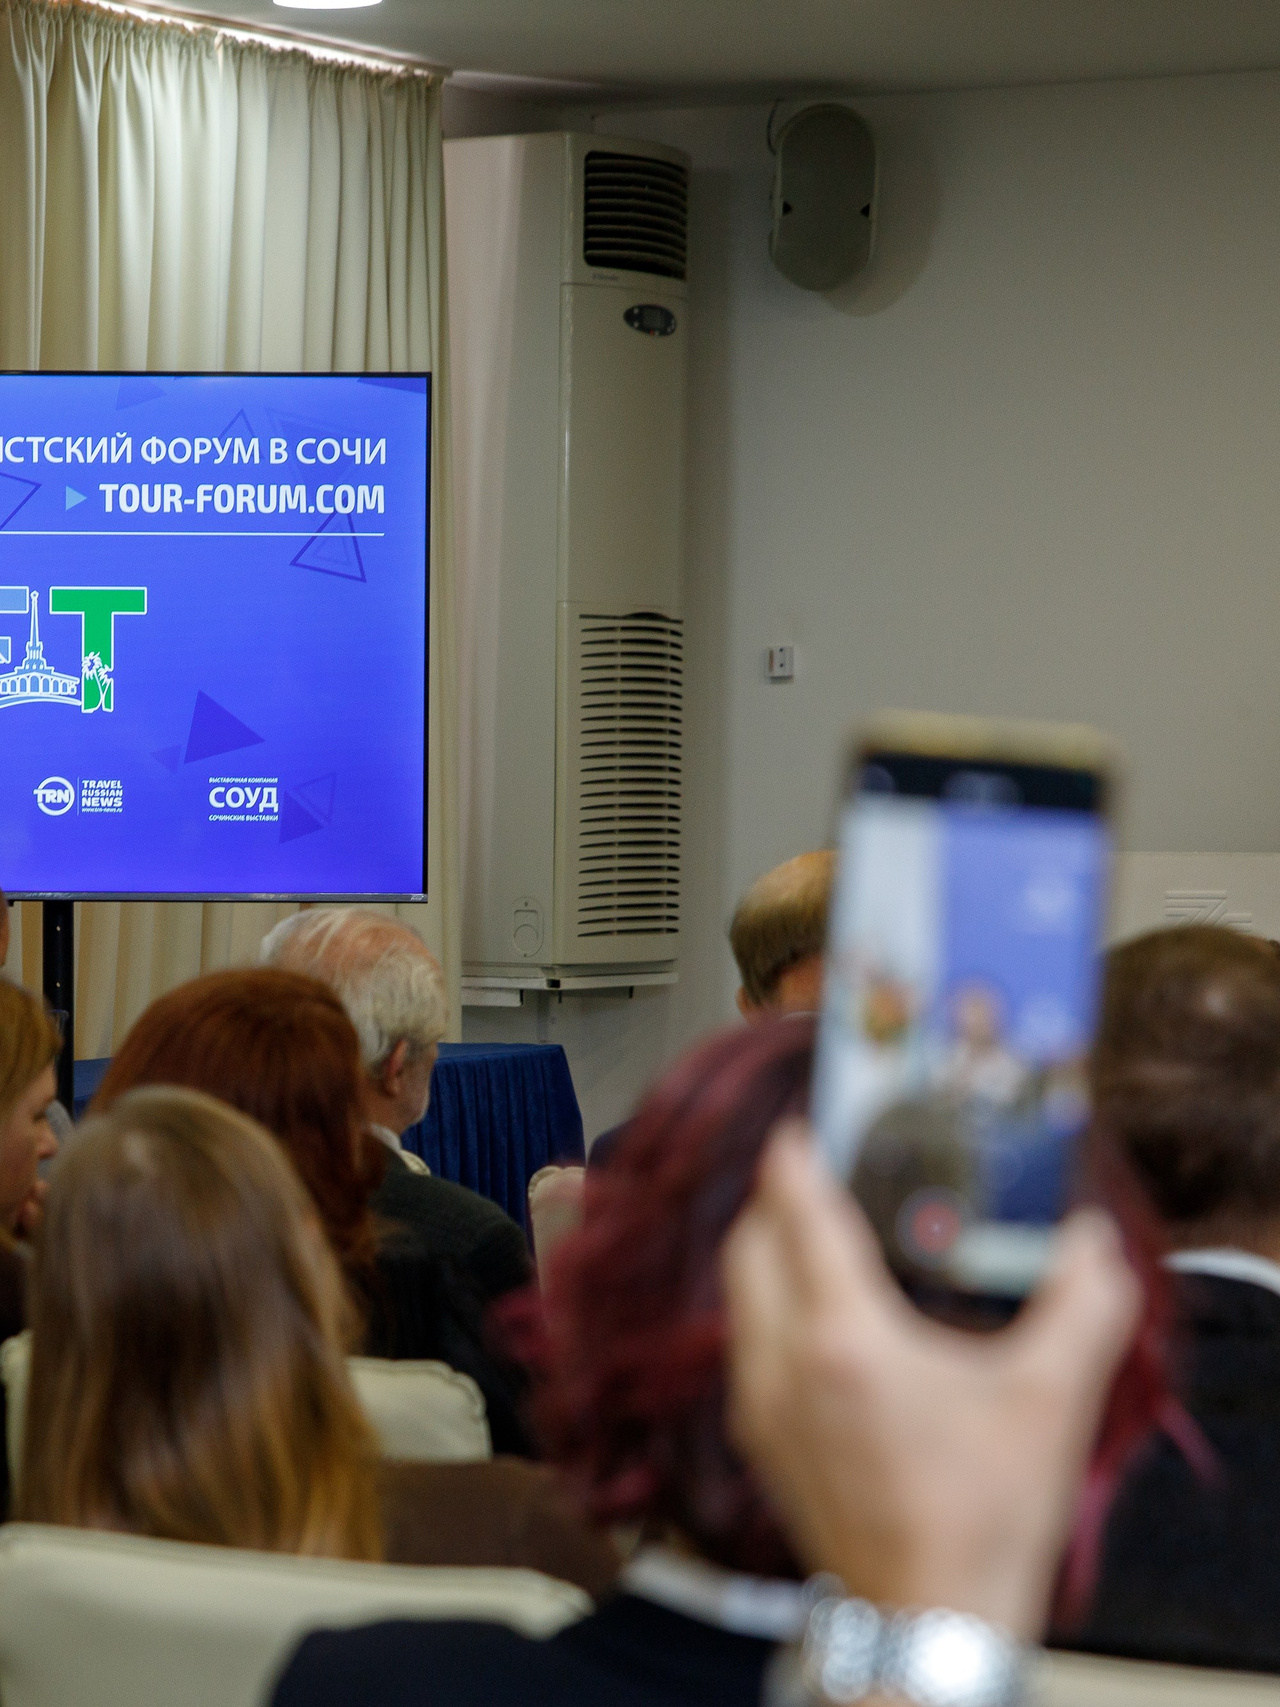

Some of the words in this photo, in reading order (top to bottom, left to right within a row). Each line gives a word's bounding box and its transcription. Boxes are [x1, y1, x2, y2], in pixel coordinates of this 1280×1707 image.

[140, 436, 260, 465] ФОРУМ
[269, 437, 288, 464] В
[296, 438, 386, 465] СОЧИ
[99, 483, 385, 514] TOUR-FORUM.COM
[81, 779, 123, 789] TRAVEL
[33, 788, 71, 804] TRN
[81, 788, 123, 797] RUSSIAN
[208, 786, 279, 813] СОУД
[81, 796, 123, 807] NEWS
